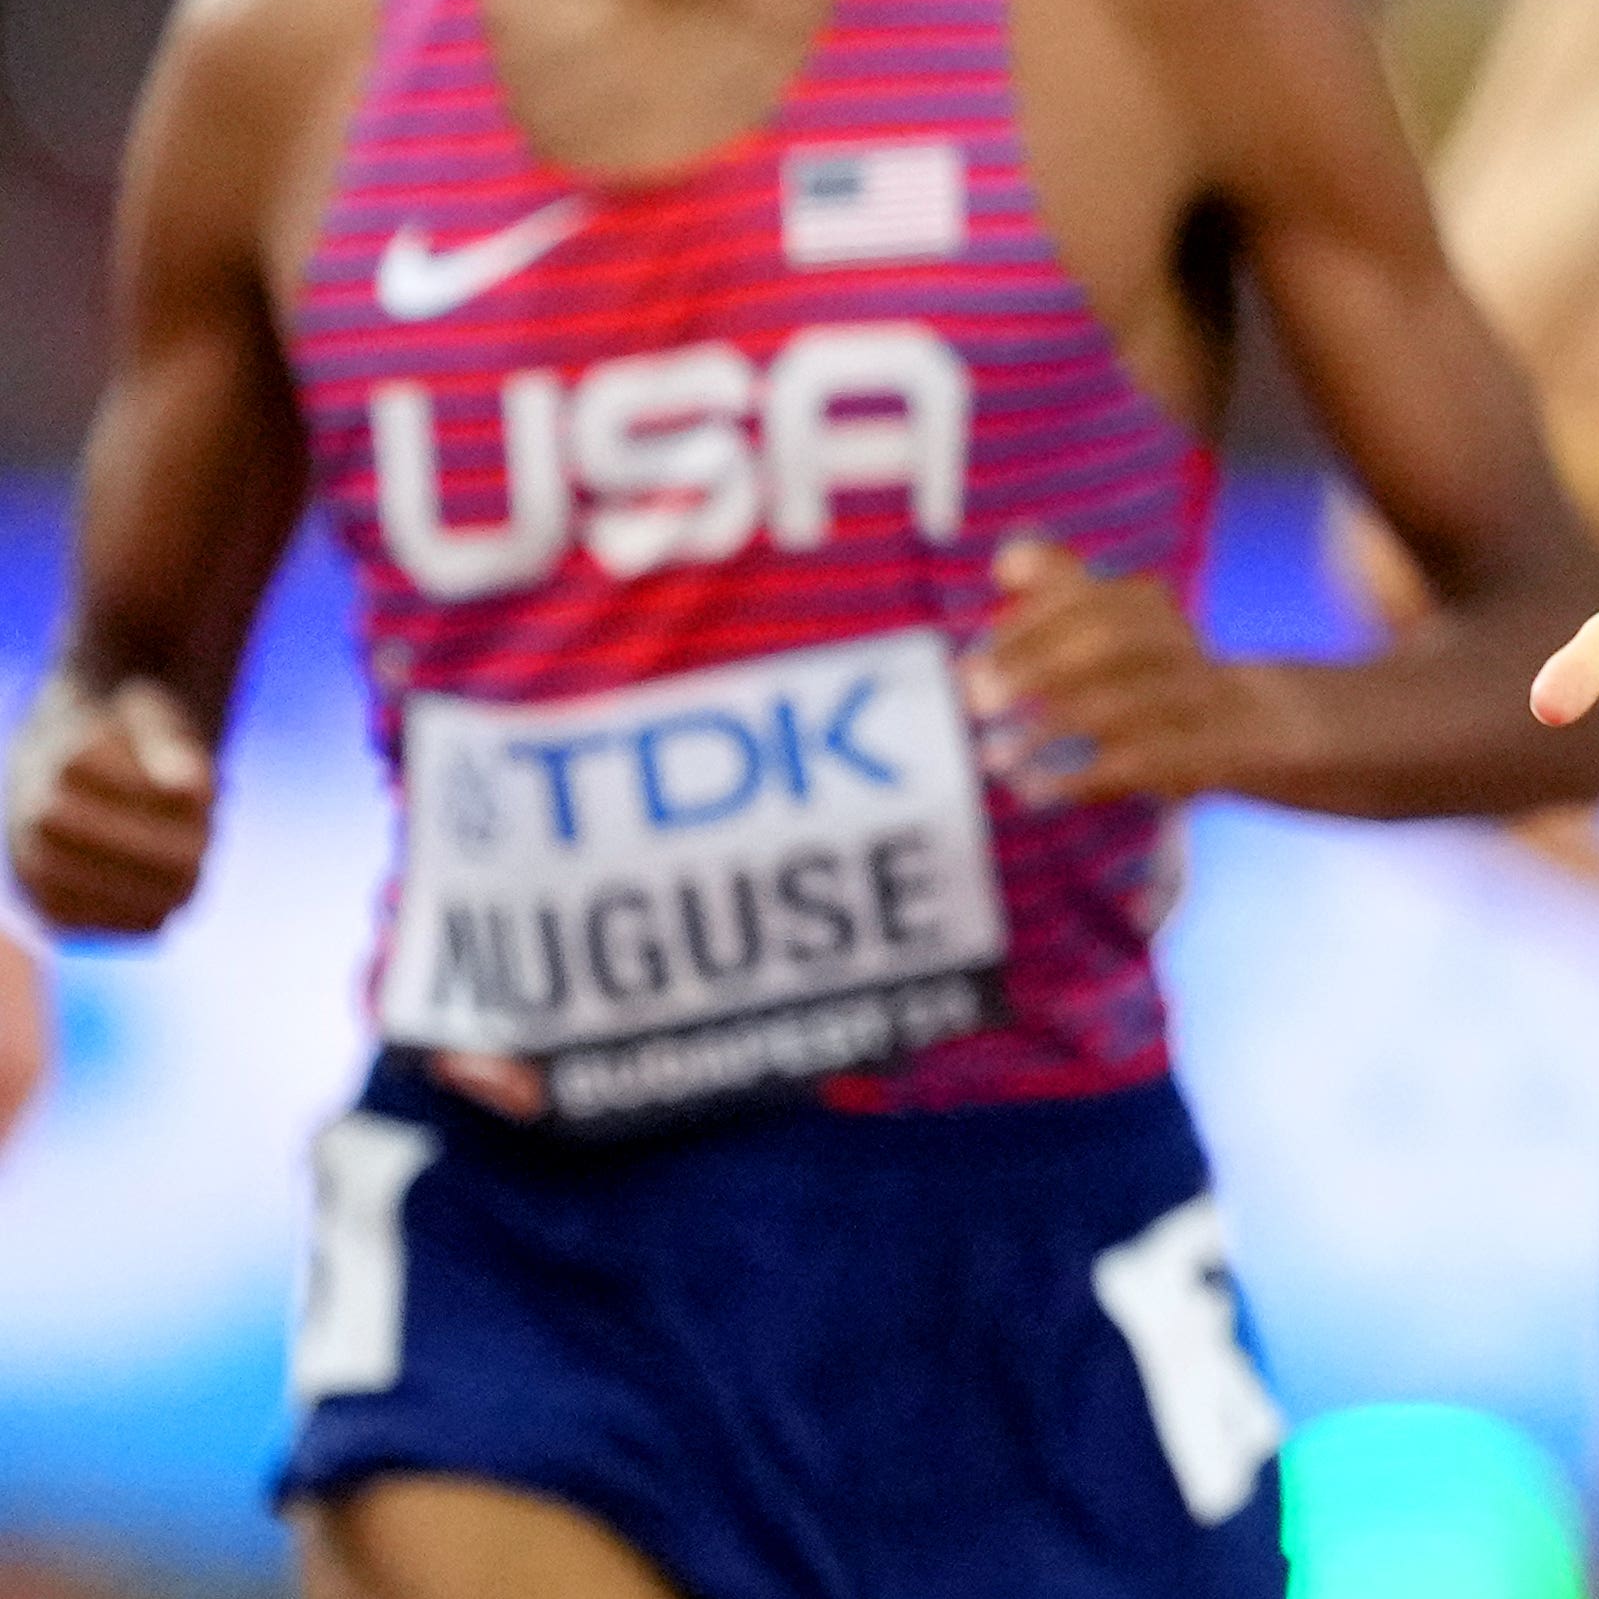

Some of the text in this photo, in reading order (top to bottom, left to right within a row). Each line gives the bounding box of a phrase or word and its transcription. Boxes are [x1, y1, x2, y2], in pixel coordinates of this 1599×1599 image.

[370, 319, 972, 601] USA
[505, 675, 899, 845] TDK
[434, 820, 938, 1012] AUGUSE
